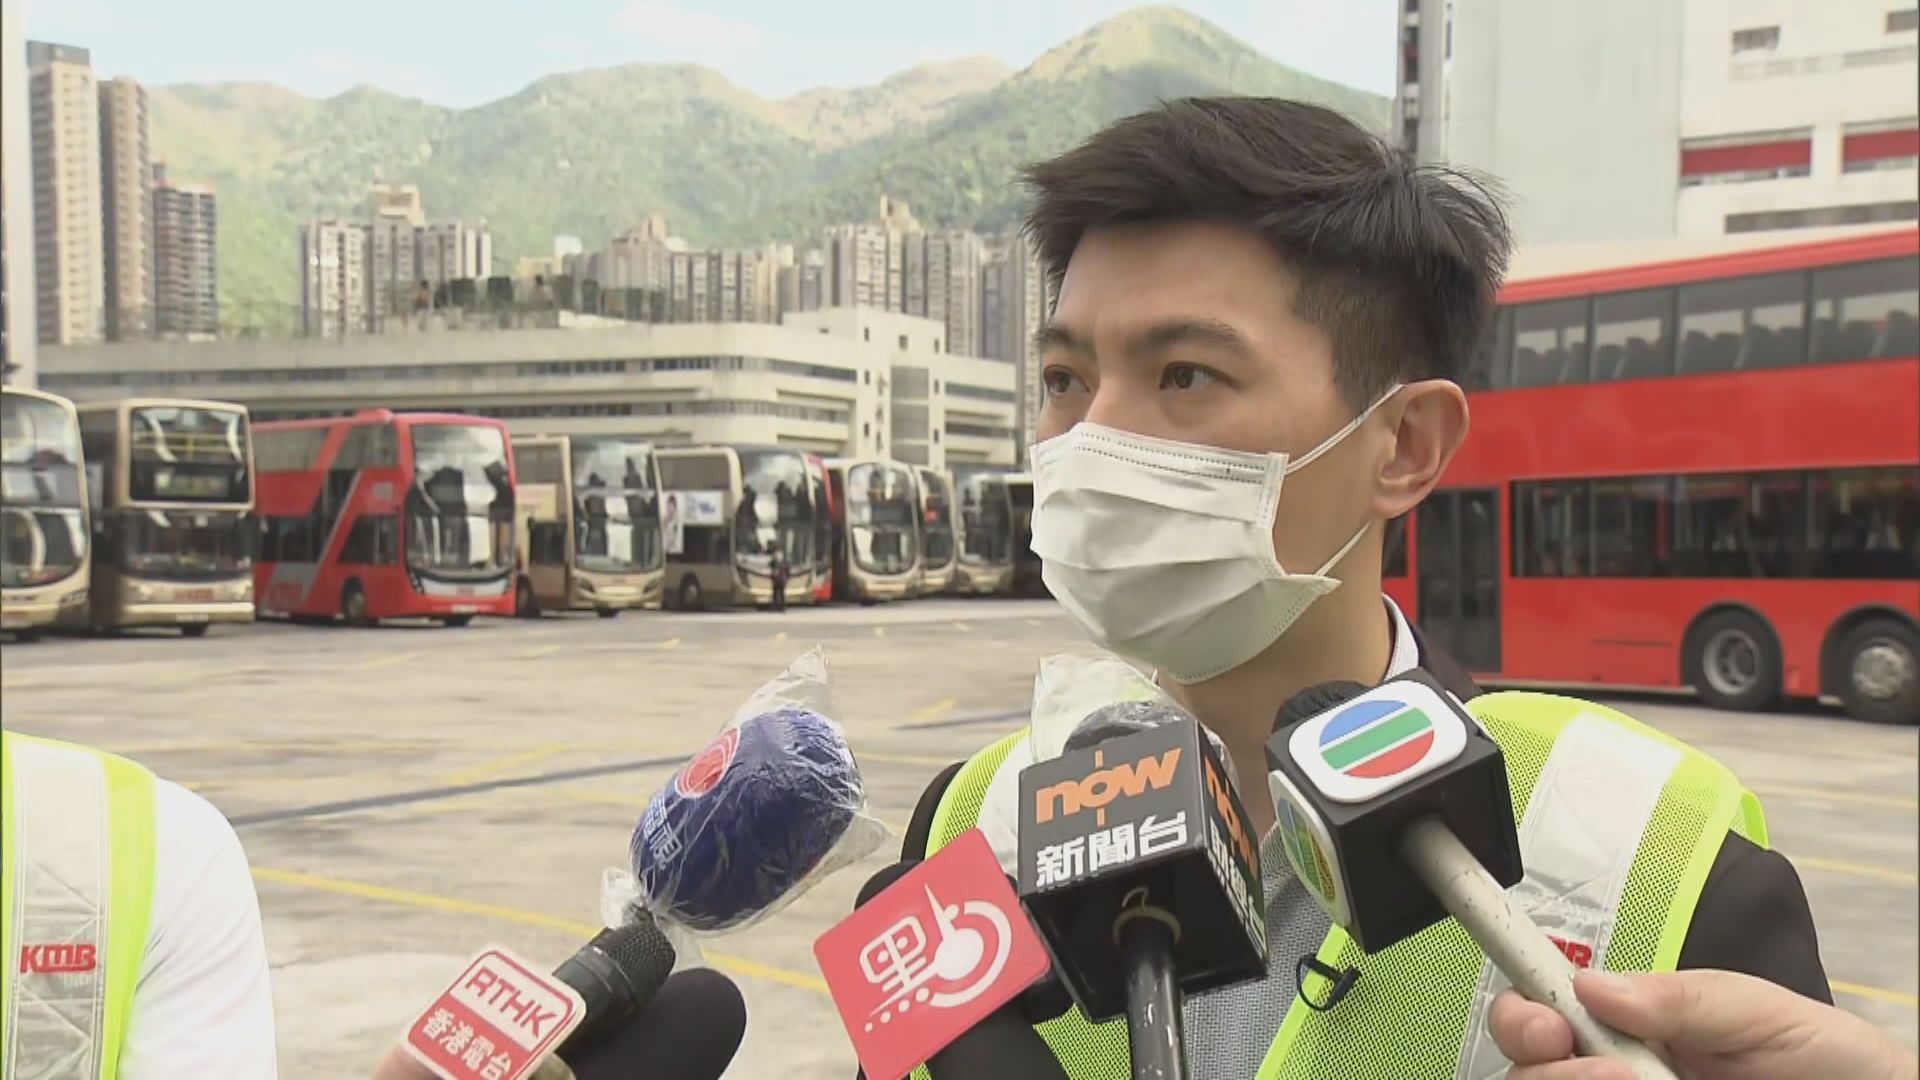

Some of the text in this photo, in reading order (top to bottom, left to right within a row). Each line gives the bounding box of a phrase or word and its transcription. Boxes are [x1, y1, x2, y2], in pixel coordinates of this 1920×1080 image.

[1036, 748, 1182, 826] now
[1205, 755, 1258, 881] now
[1036, 810, 1188, 888] 新聞台
[20, 944, 96, 973] KMB
[464, 966, 558, 1038] RTHK
[422, 1008, 512, 1080] 香港電台
